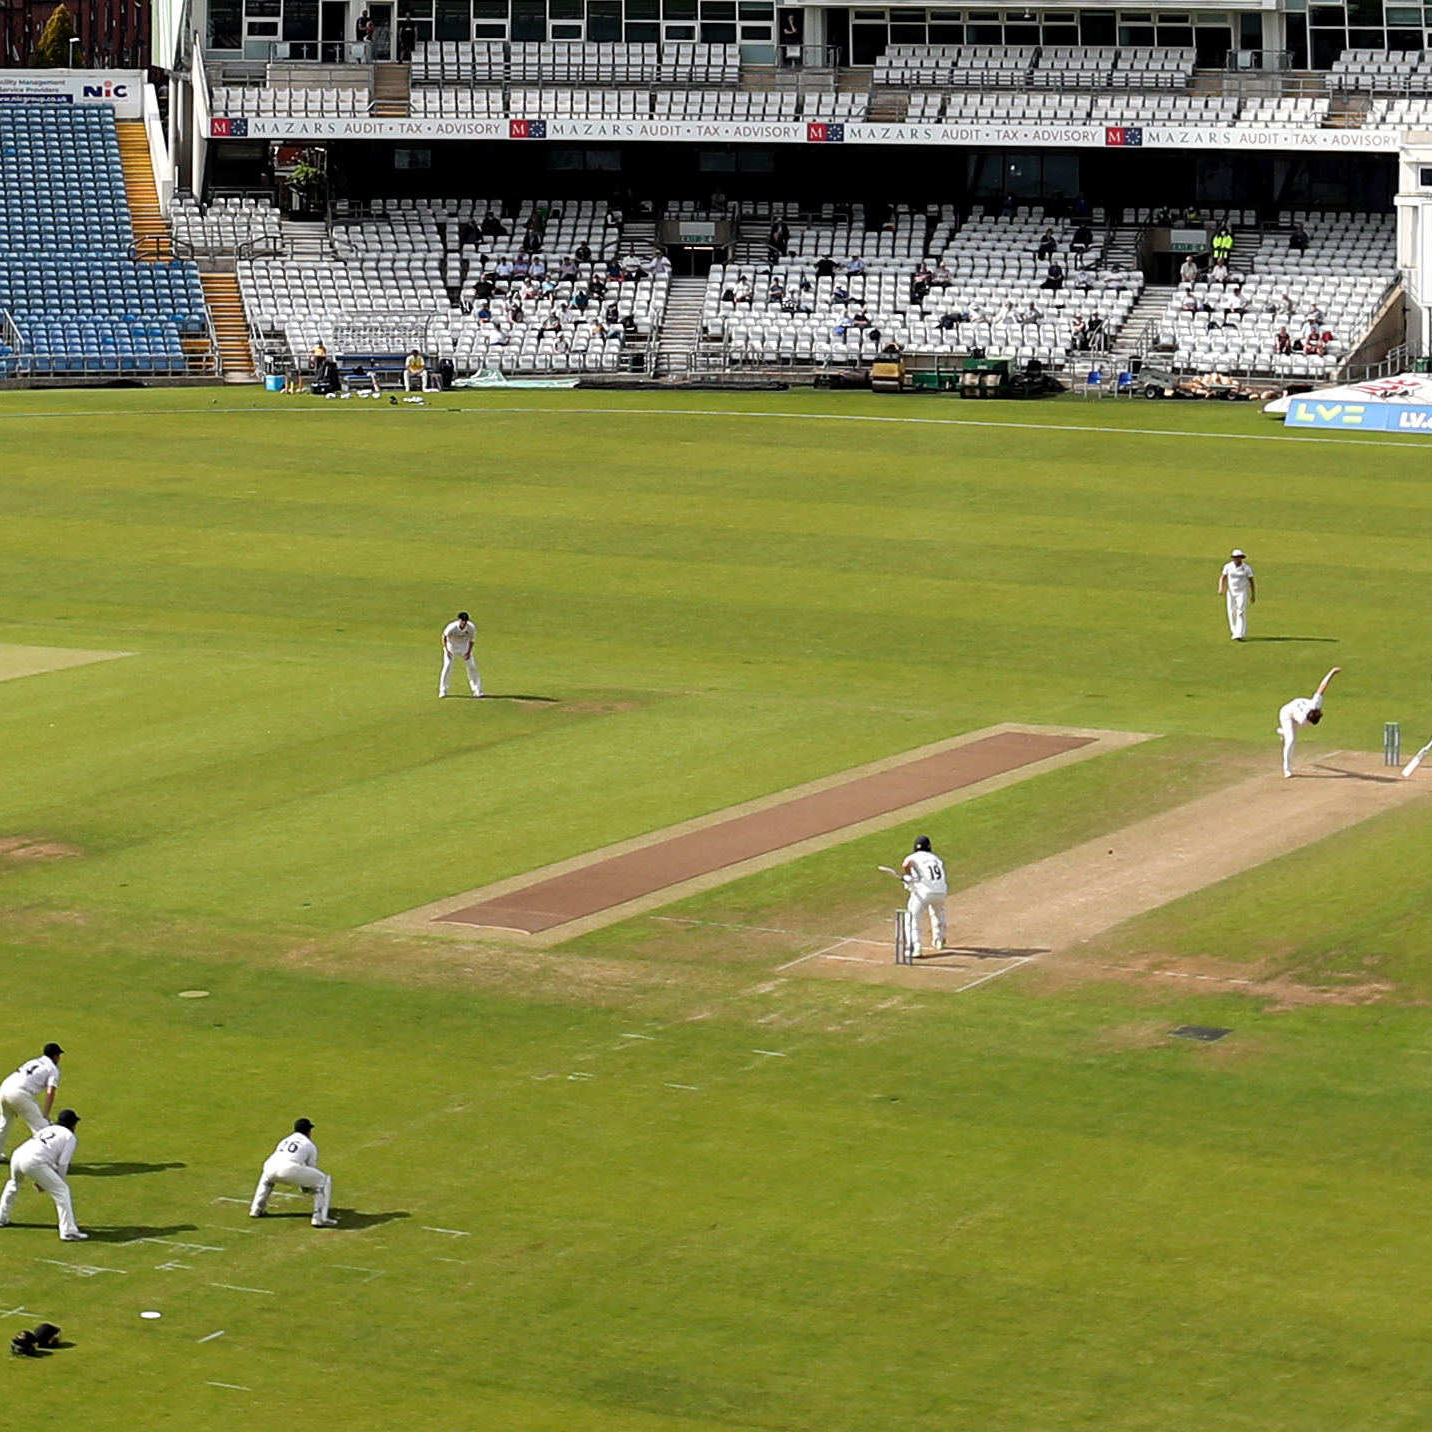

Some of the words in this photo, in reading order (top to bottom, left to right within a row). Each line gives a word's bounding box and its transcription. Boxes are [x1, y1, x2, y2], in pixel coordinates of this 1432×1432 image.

[213, 122, 227, 133] M
[253, 123, 336, 134] MAZARS
[344, 123, 384, 134] AUDIT
[398, 123, 422, 134] TAX
[436, 123, 501, 135] ADVISORY
[512, 123, 525, 135] M
[552, 124, 634, 135] MAZARS
[639, 125, 681, 136] AUDIT
[696, 125, 720, 136] TAX
[733, 126, 800, 137] ADVISORY
[810, 126, 823, 138] M
[850, 128, 932, 139] MAZARS
[941, 129, 980, 140] AUDIT
[995, 129, 1019, 140] TAX
[1032, 130, 1098, 141] ADVISORY
[1108, 131, 1121, 143] M
[1148, 132, 1231, 143] MAZARS
[1239, 133, 1279, 144] AUDIT
[1292, 134, 1316, 145] TAX
[1332, 134, 1398, 146] ADVISORY
[928, 865, 942, 880] 19
